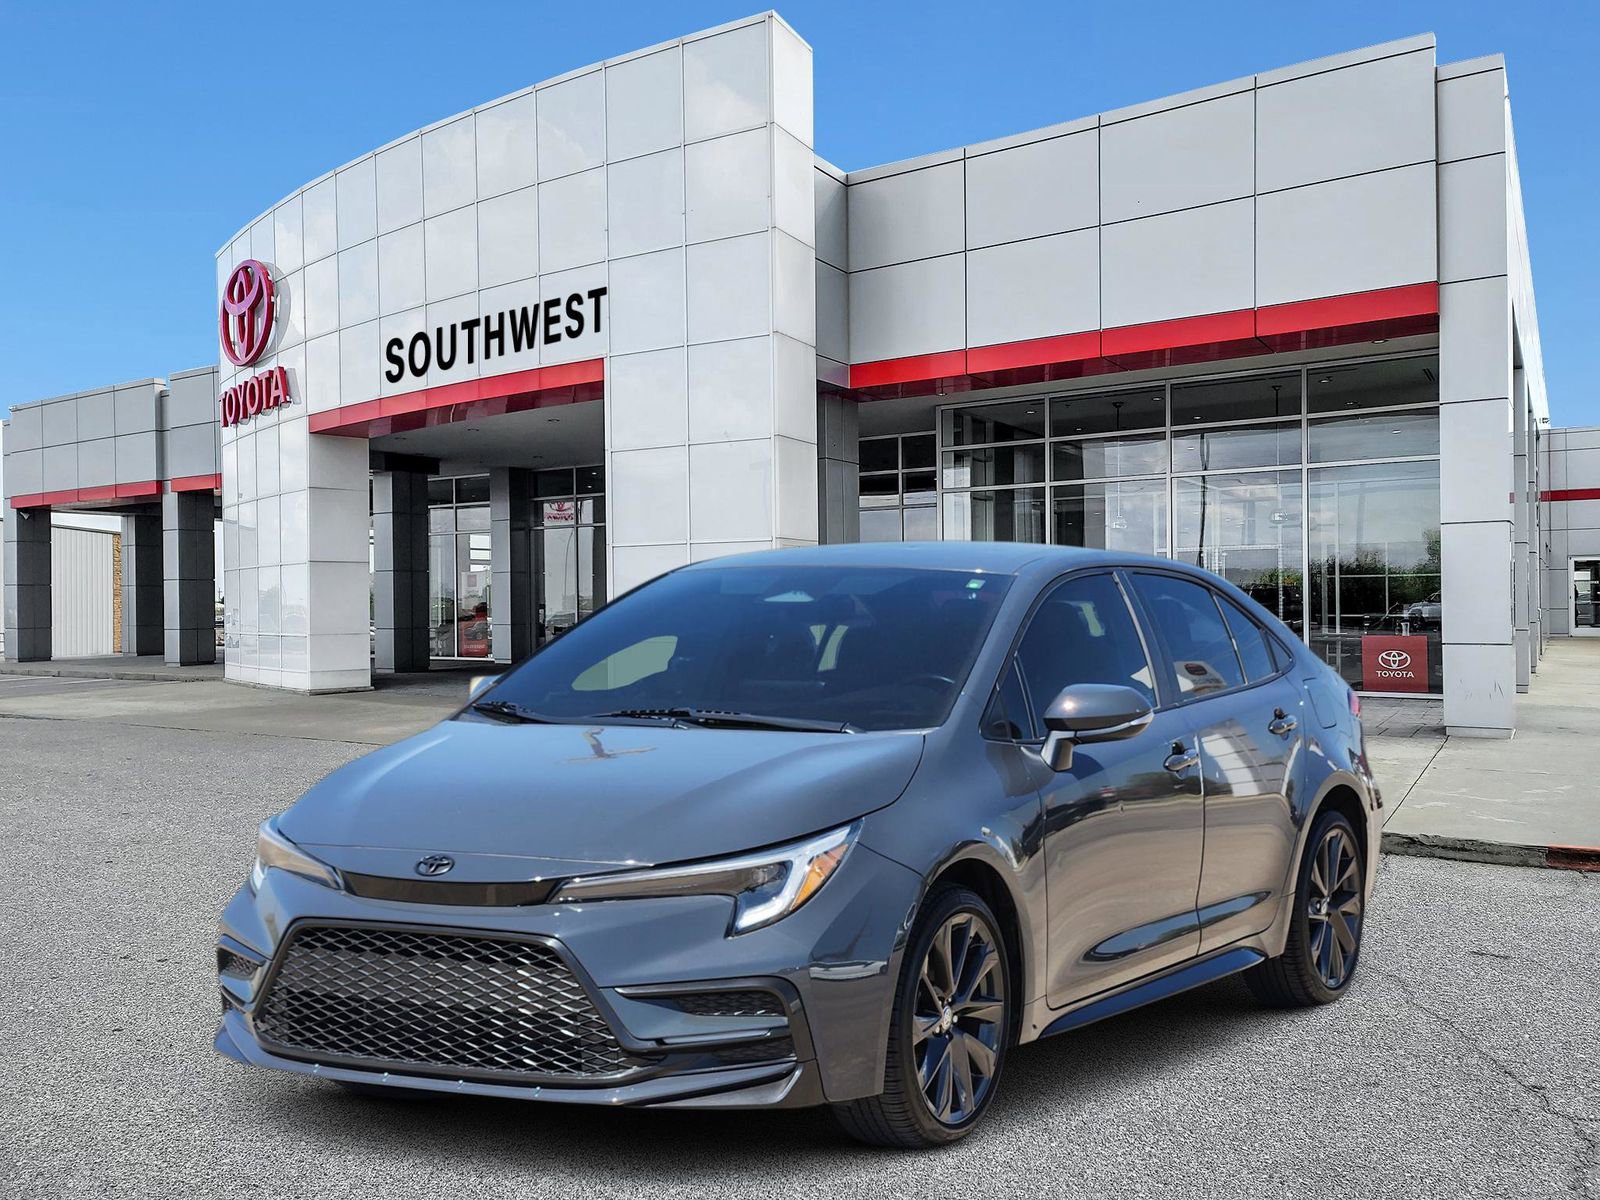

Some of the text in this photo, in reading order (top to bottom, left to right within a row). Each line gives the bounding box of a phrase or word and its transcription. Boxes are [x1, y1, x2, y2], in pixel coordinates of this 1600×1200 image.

[385, 286, 608, 384] SOUTHWEST
[218, 366, 289, 428] TOYOTA
[1375, 670, 1415, 678] TOYOTA
